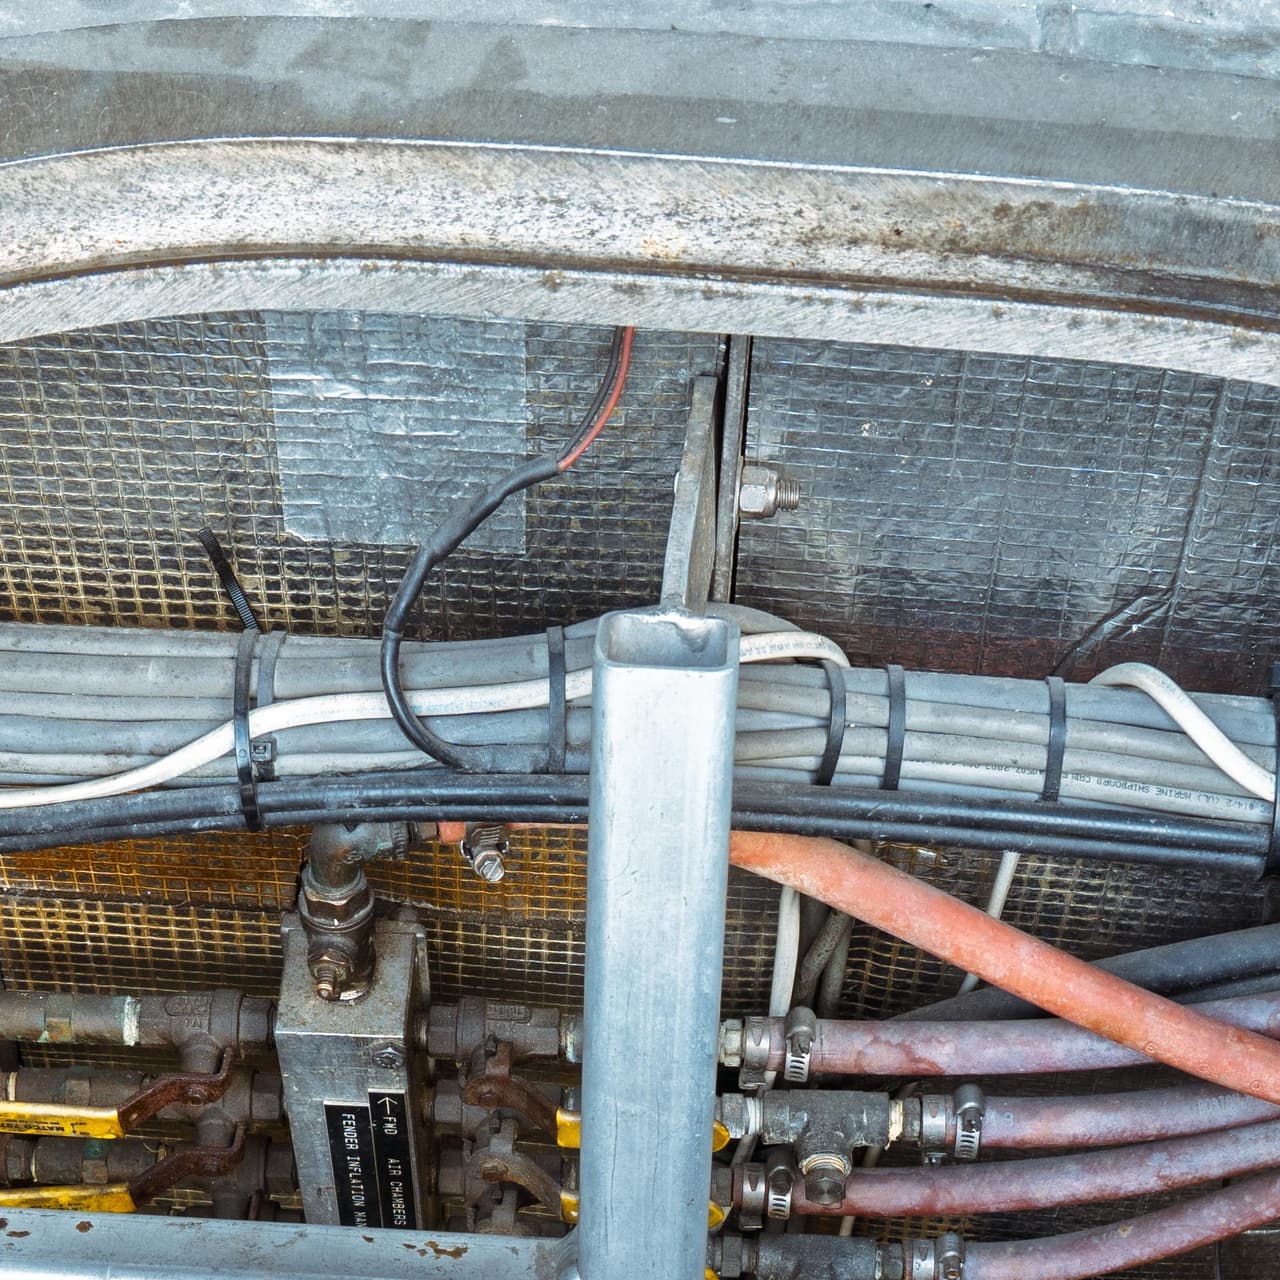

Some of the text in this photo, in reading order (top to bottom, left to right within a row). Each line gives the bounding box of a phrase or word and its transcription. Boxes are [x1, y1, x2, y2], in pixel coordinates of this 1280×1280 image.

[1155, 786, 1191, 801] MARINE
[24, 1123, 65, 1133] MATCO
[341, 1113, 359, 1151] FENDER
[346, 1155, 366, 1207] INFLATION
[382, 1116, 407, 1226] FWD AIR CHAMBERS
